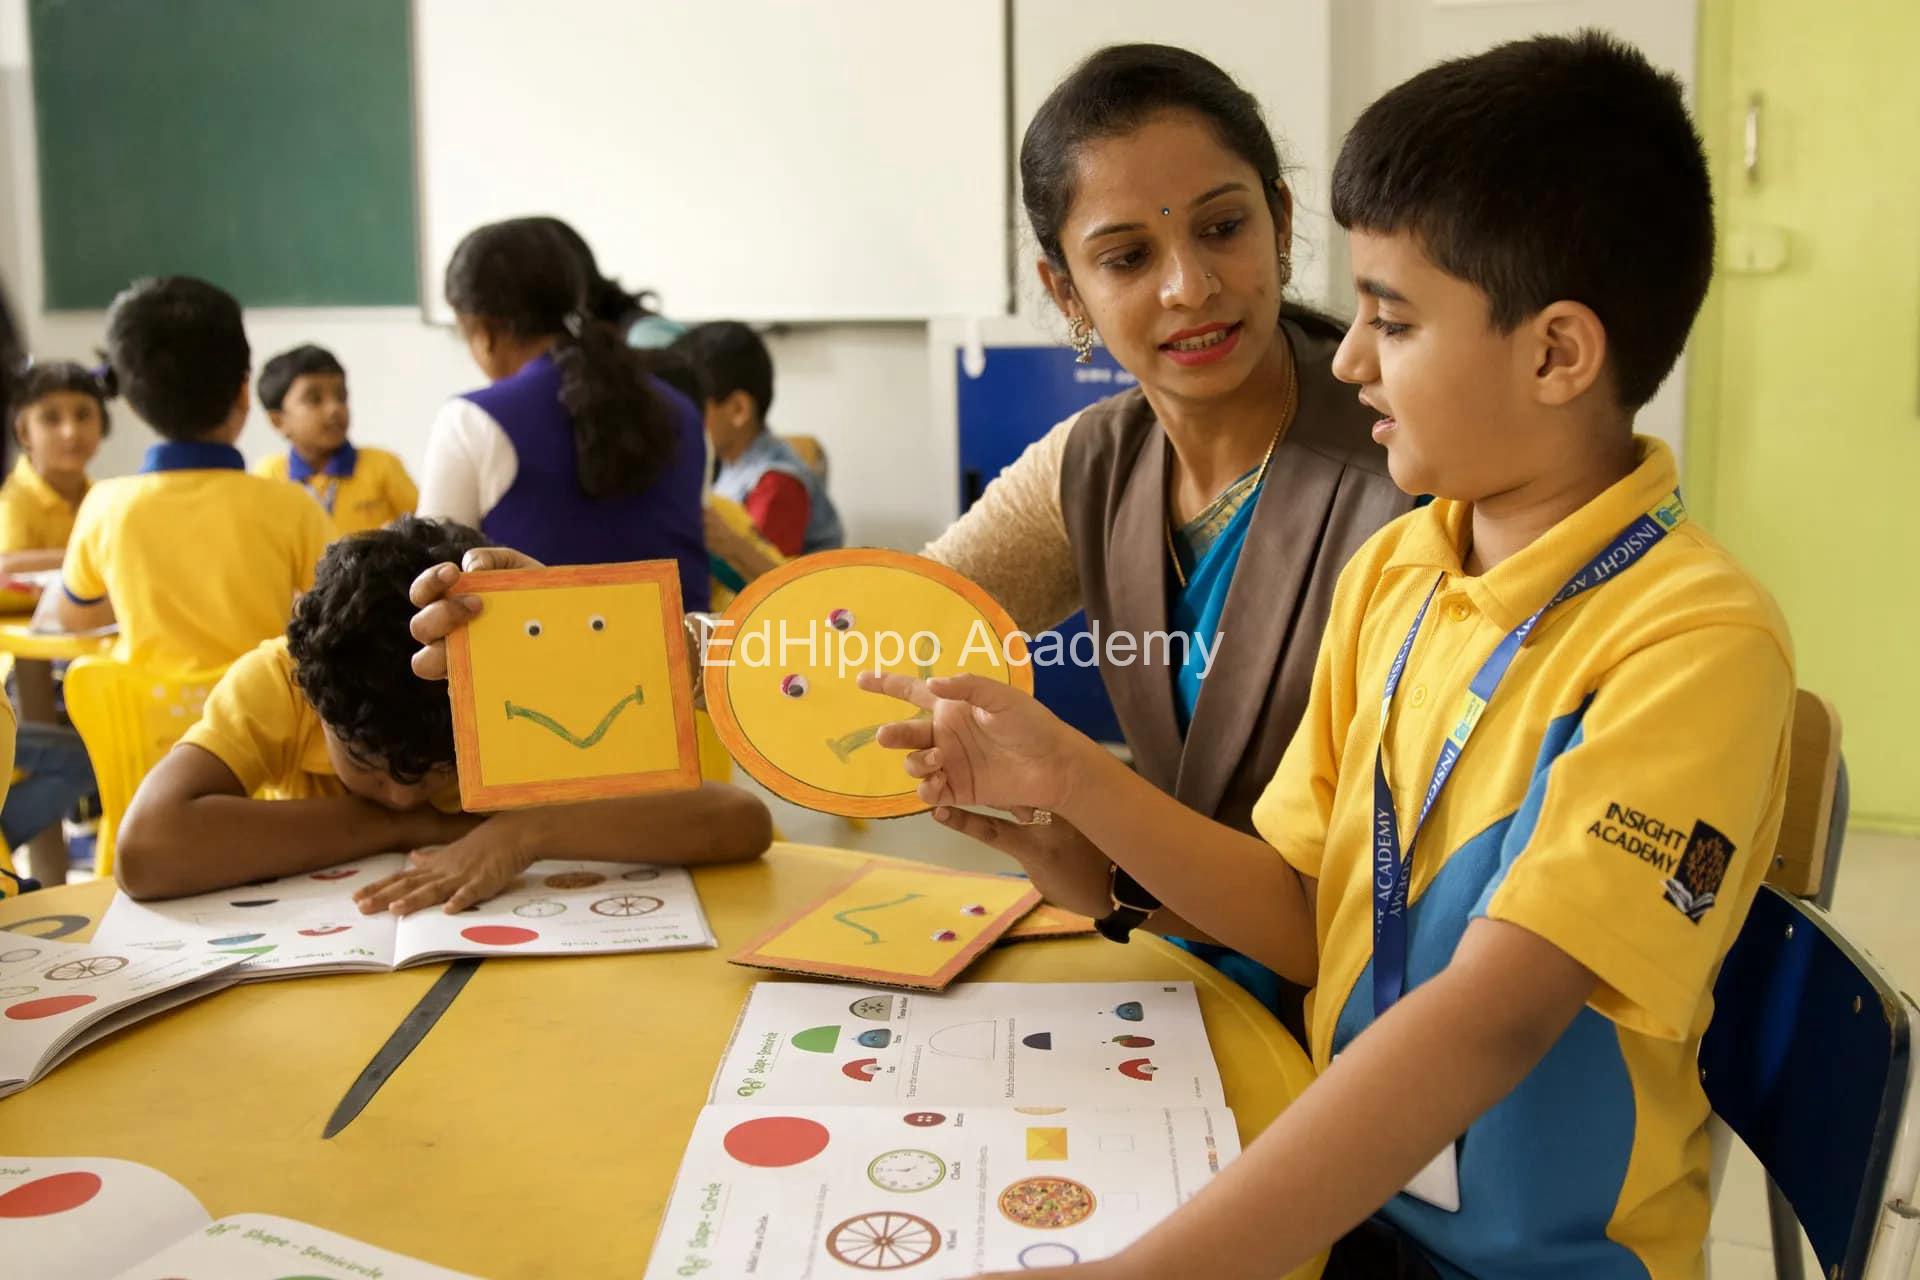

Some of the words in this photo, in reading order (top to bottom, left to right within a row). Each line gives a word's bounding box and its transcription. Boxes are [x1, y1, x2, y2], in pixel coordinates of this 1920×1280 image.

[1593, 522, 1658, 582] INSIGHT
[1586, 820, 1678, 874] ACADEMY
[1605, 801, 1688, 851] INSIGHT
[1377, 808, 1393, 902] ACADEMY
[950, 1160, 961, 1181] Clock
[700, 1182, 722, 1212] Circle
